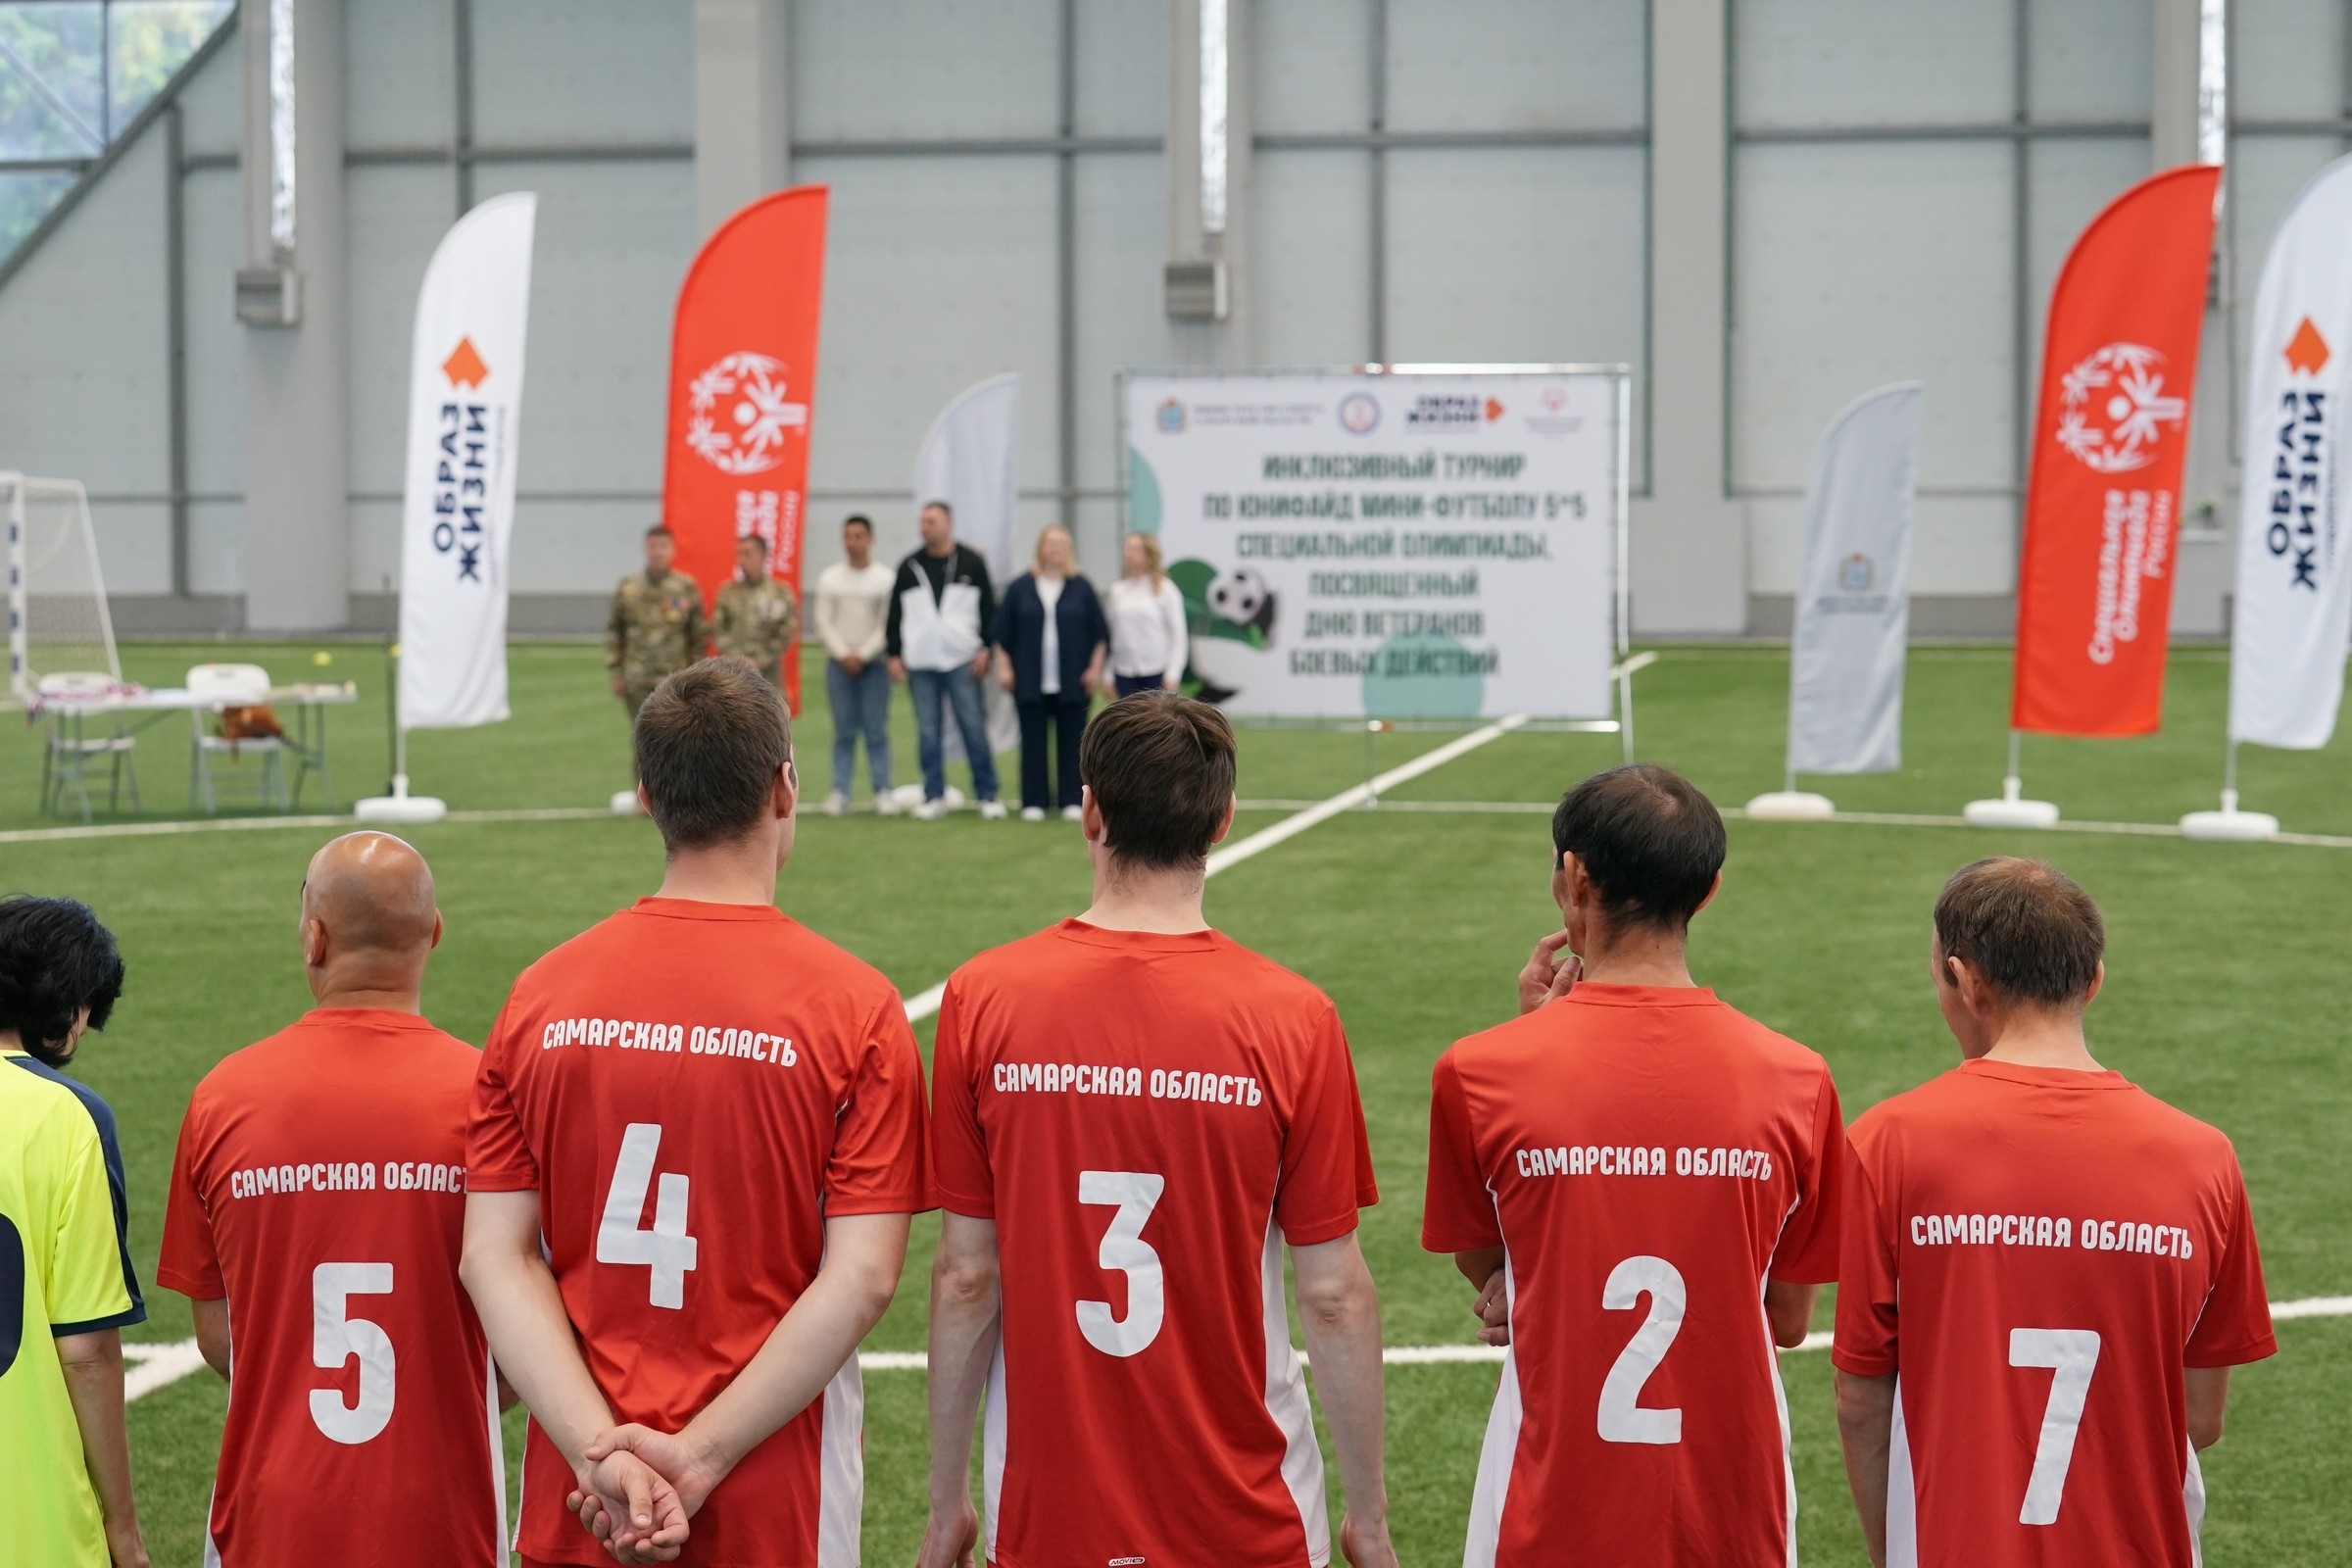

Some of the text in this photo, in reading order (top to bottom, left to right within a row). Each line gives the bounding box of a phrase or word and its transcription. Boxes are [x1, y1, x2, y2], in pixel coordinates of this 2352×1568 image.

[433, 404, 460, 553] ОБРАЗ
[1262, 449, 1526, 480] ИНКЛЮЗИВНЫЙ ТУРНИР
[2268, 392, 2298, 556] ОБРАЗ
[459, 406, 487, 583] ЖИЗНИ
[1202, 493, 1231, 519] ПО
[1237, 489, 1354, 521] ЮНИФАЙД
[1359, 493, 1536, 520] МИНИ-ФУТБОЛУ
[2291, 393, 2326, 590] ЖИЗНИ
[1237, 527, 1394, 560] СПЕЦИАЛЬНОЙ
[1304, 610, 1485, 638] ДНЮ ВЕТЕРАНОВ
[1290, 644, 1500, 677] БОЕВЫХ ДЕЙСТВИЙ
[543, 1017, 798, 1067] САМАРСКАЯ ОБЛАСТЬ
[994, 1062, 1262, 1106] САМАРСКАЯ ОБЛАСТЬ
[231, 1162, 375, 1200] САМАРСКАЯ
[1516, 1146, 1772, 1181] САМАРСКАЯ ОБЛАСТЬ
[596, 1122, 698, 1310] 4
[1910, 1214, 2193, 1260] САМАРСКАЯ ОБЛАСТЬ
[1075, 1170, 1165, 1358] 3
[309, 1261, 396, 1445] 5
[1596, 1255, 1687, 1445] 2
[2008, 1327, 2101, 1526] 7
